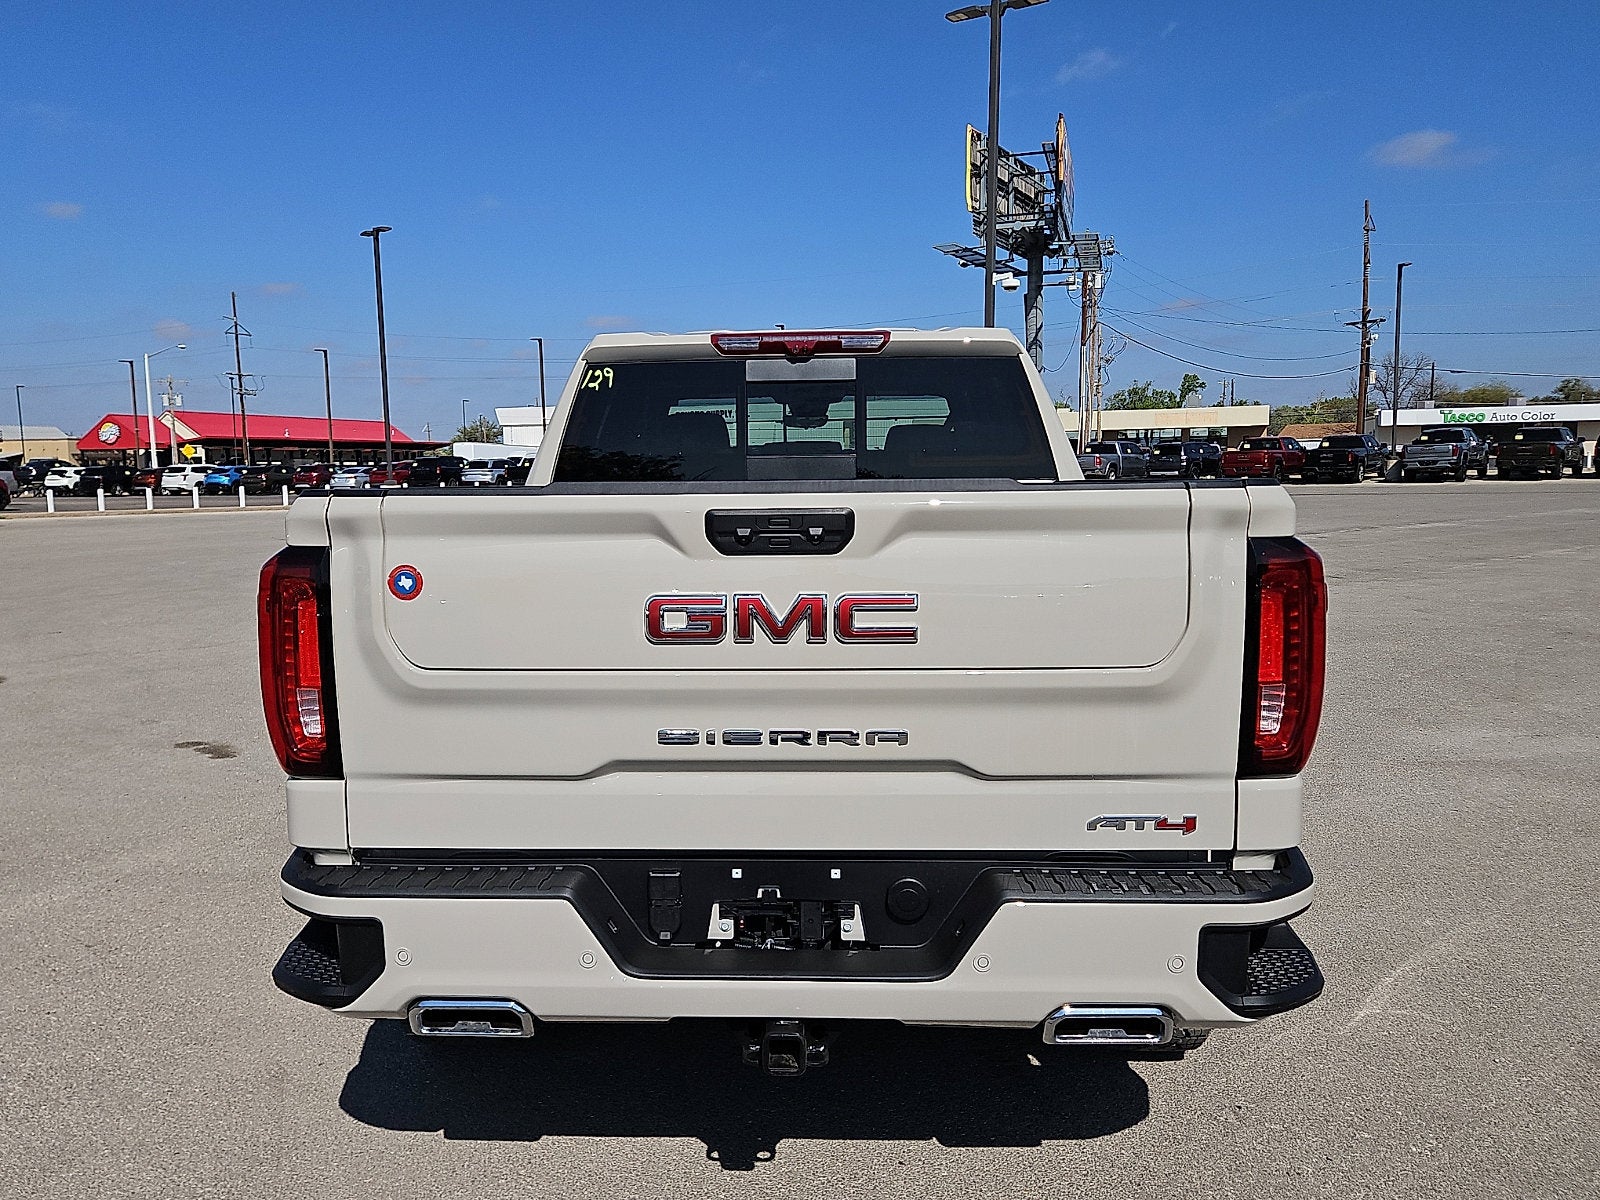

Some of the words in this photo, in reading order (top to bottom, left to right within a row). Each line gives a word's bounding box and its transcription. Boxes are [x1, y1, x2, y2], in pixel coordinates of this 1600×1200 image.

[581, 367, 614, 391] 129
[1440, 410, 1486, 423] TASCO
[1490, 412, 1518, 421] Auto
[1521, 411, 1556, 420] Color
[644, 593, 919, 645] GMC
[656, 729, 909, 746] SIERRA
[1086, 814, 1198, 836] AT4
